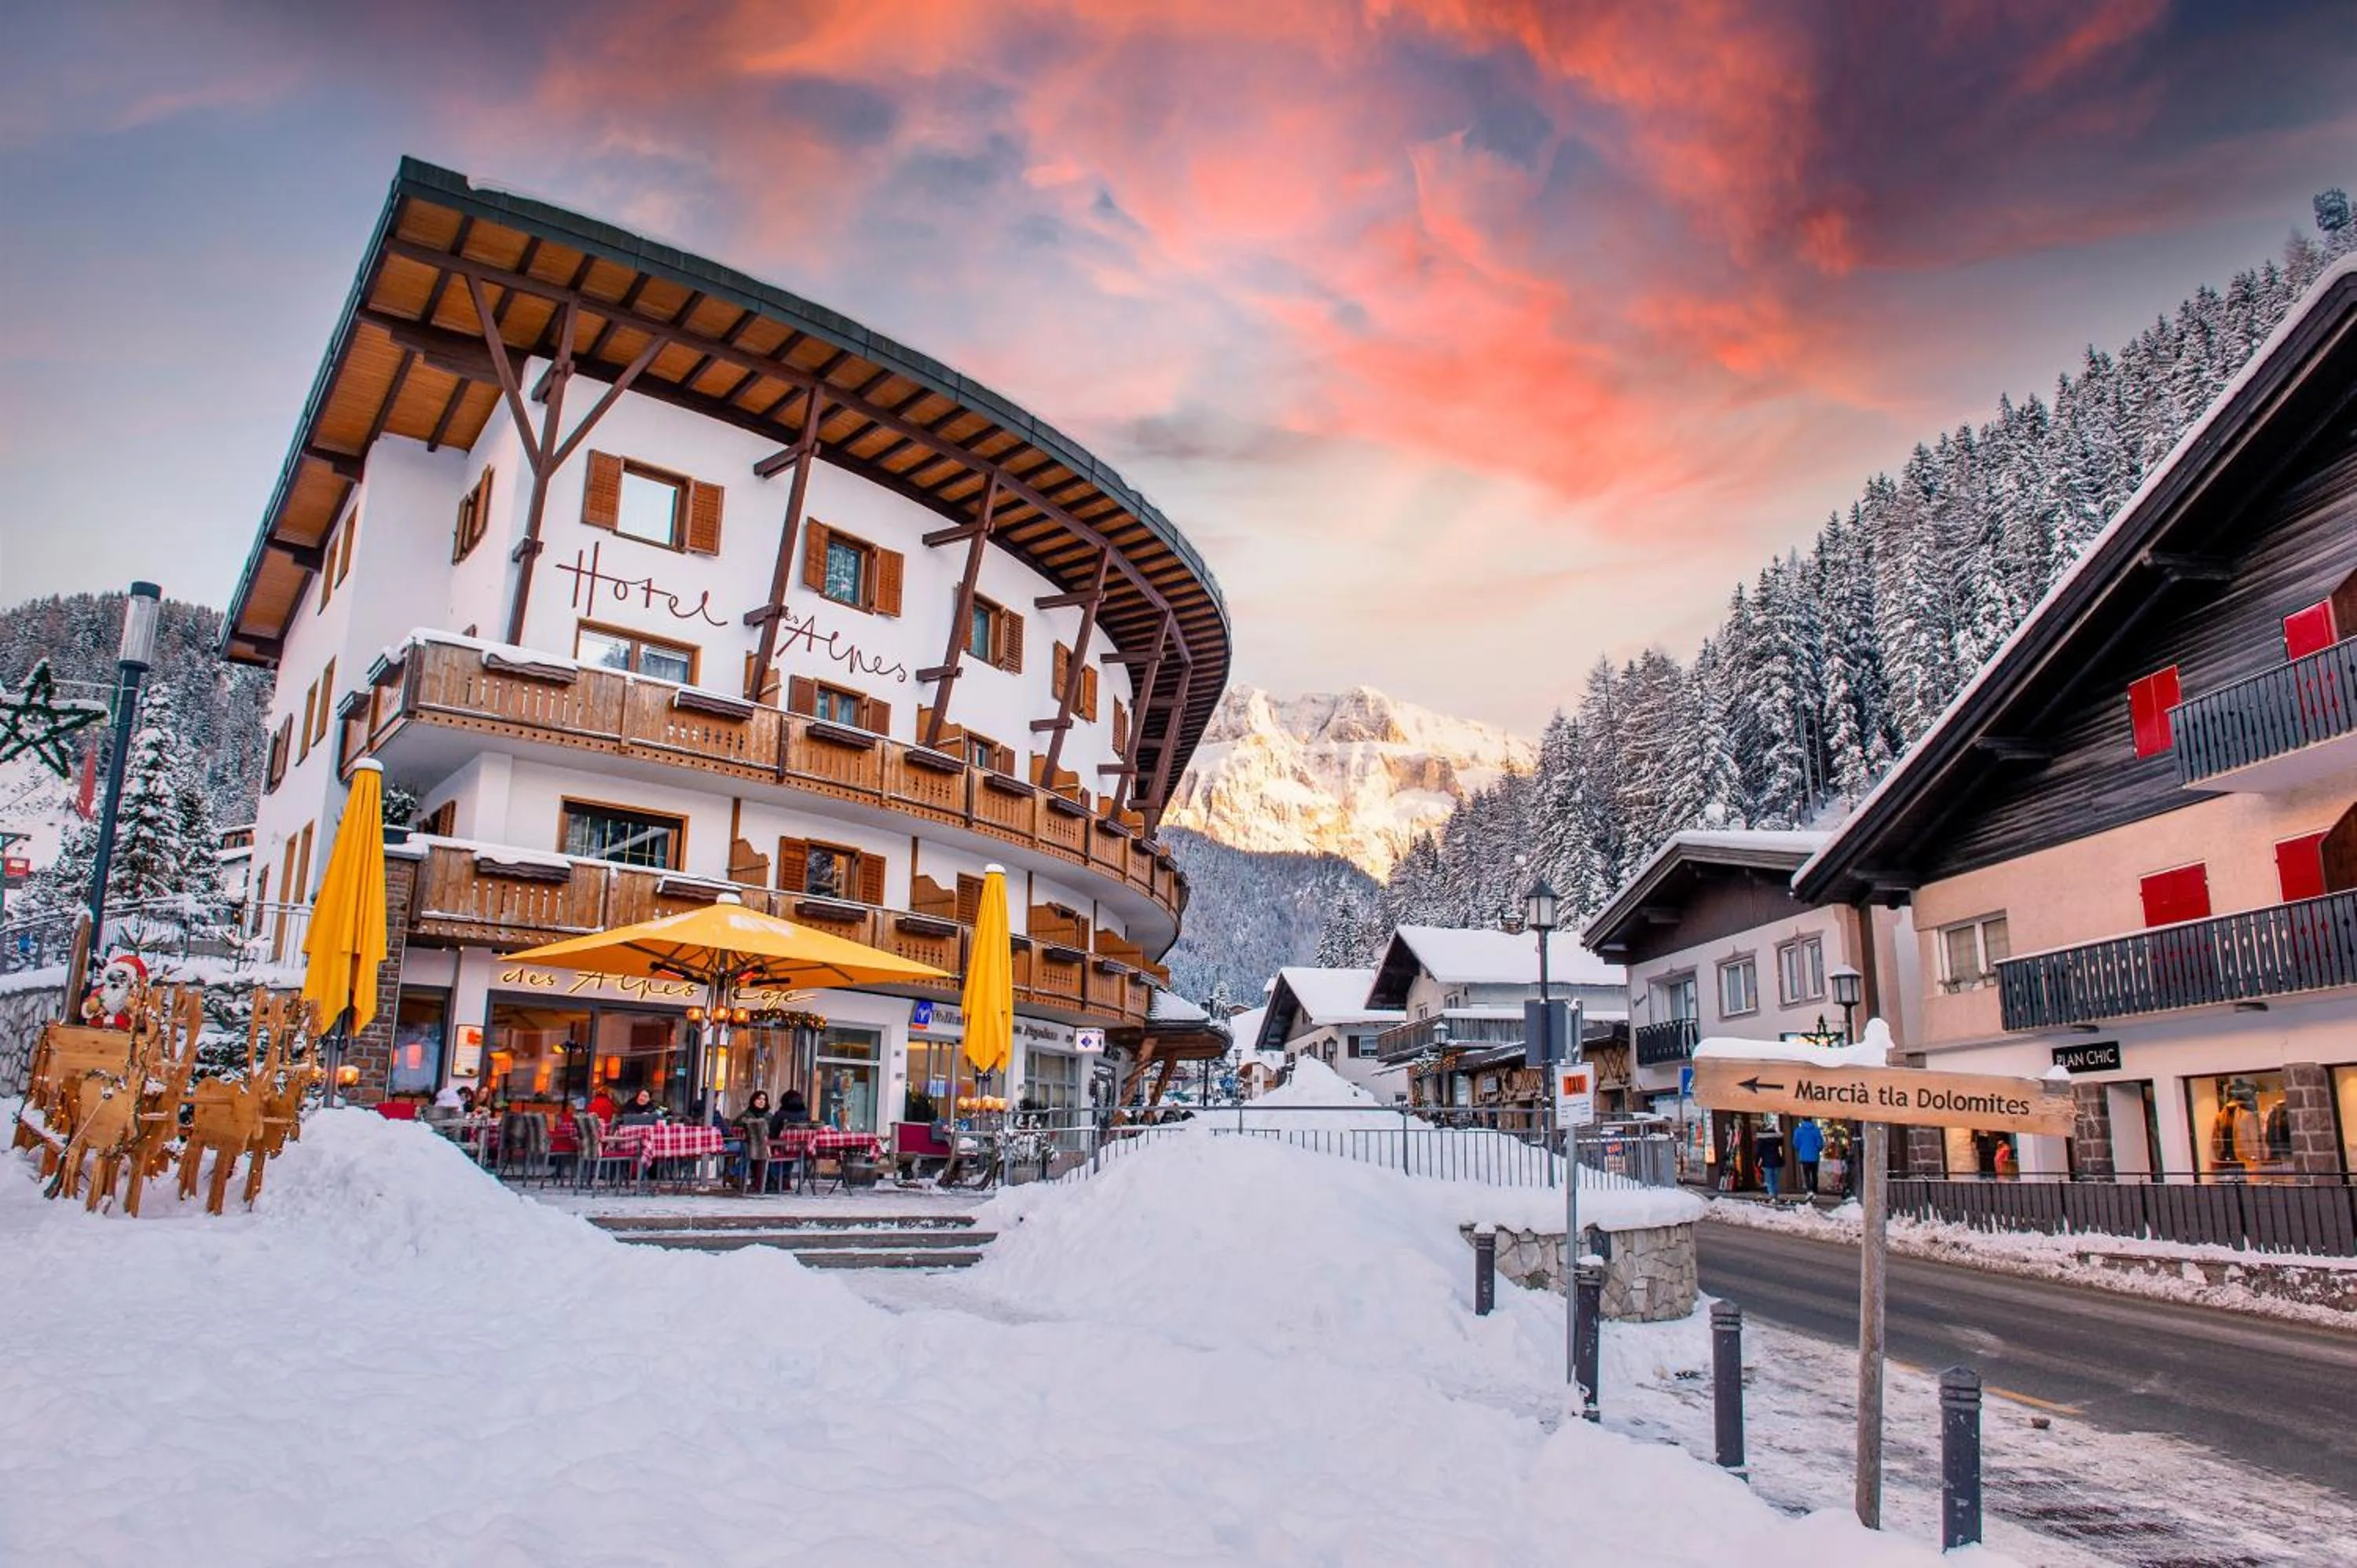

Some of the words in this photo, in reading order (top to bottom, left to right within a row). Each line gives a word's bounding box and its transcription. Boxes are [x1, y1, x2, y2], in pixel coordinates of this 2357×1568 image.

[555, 541, 728, 626] Hotel
[775, 615, 907, 682] Alpes
[502, 968, 555, 986] des
[2056, 1052, 2084, 1068] PLAN
[2086, 1049, 2116, 1065] CHIC
[1794, 1079, 1869, 1104] Marcià
[1879, 1086, 1908, 1107] tla
[1917, 1088, 2030, 1115] Dolomites
